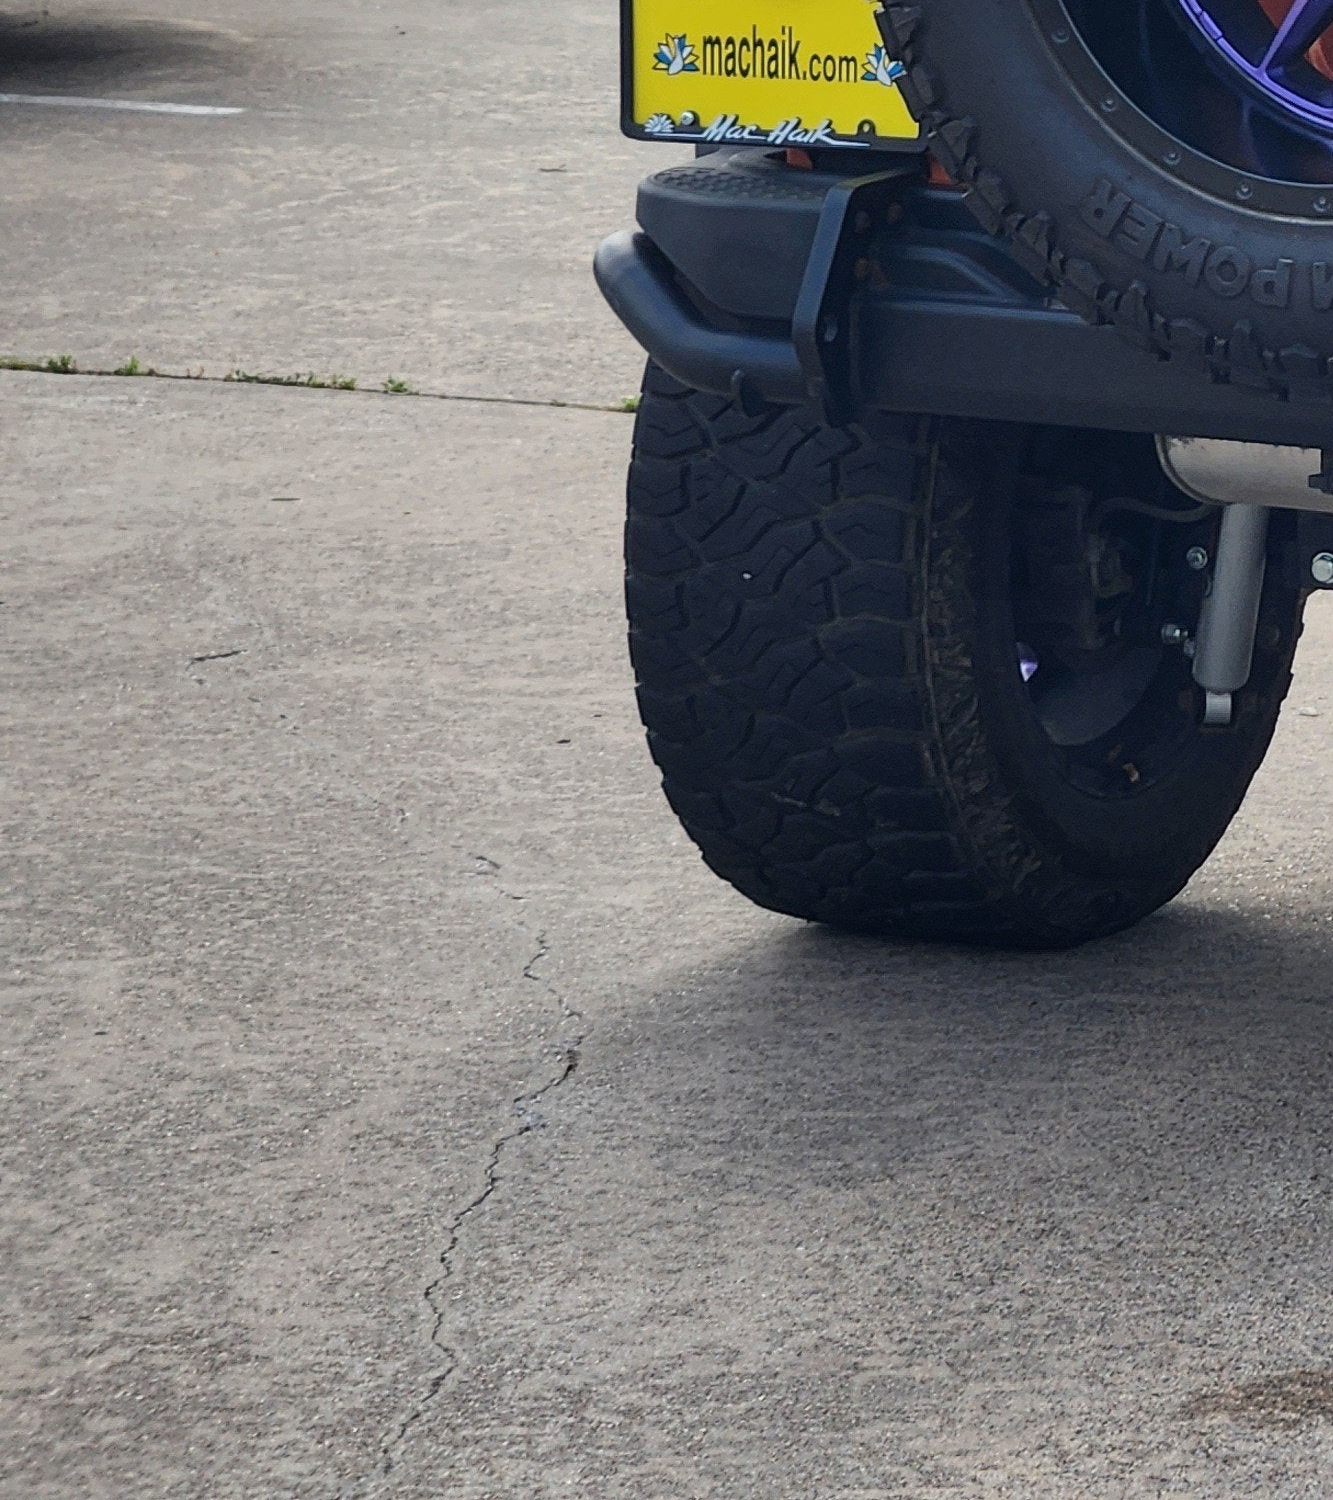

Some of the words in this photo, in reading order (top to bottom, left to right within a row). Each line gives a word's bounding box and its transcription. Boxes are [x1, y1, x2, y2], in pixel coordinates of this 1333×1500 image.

[702, 24, 859, 83] machaik.com
[702, 114, 758, 143] Mac
[767, 116, 836, 145] Haik
[1080, 177, 1295, 310] POWER
